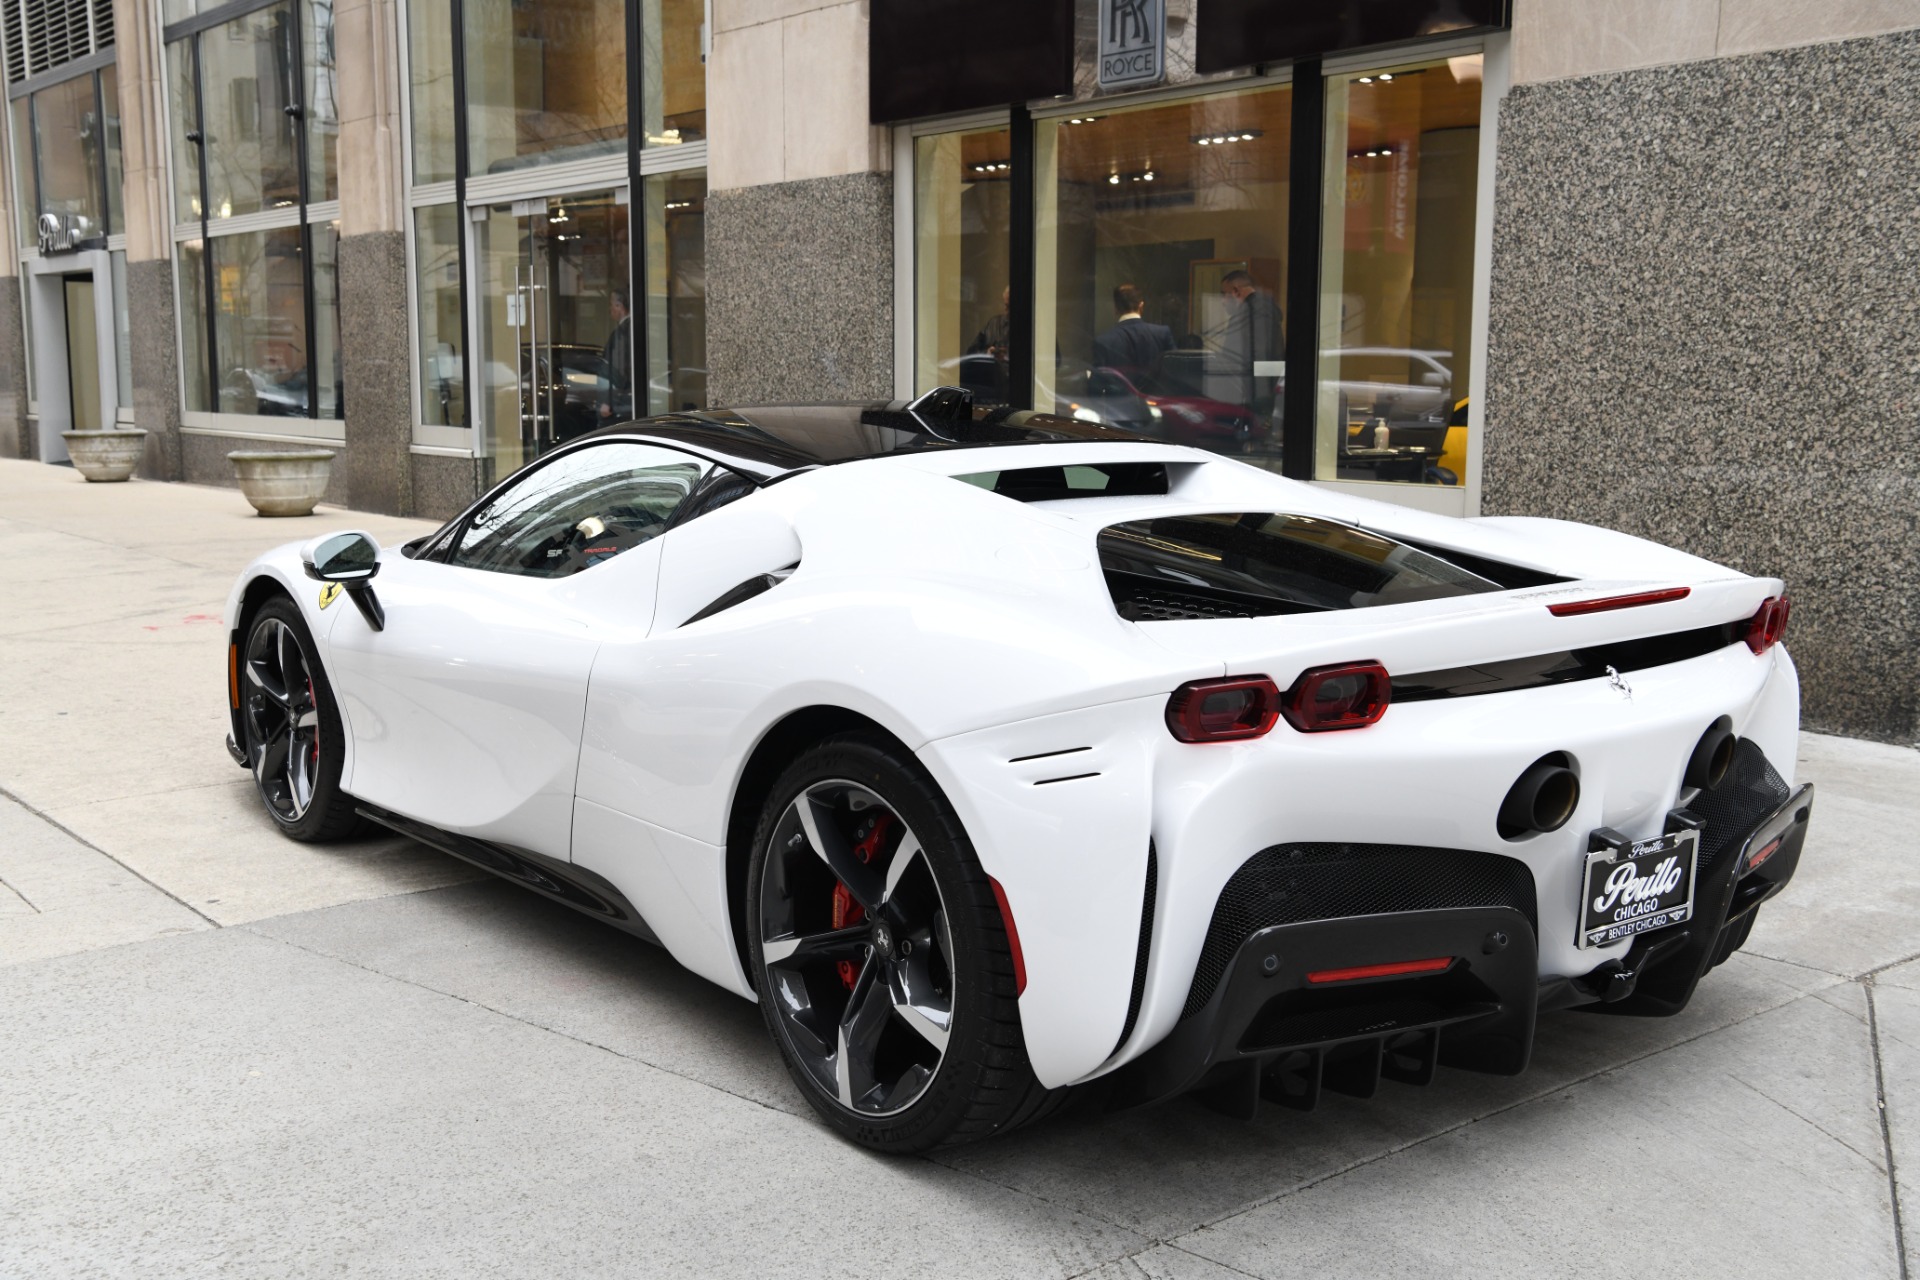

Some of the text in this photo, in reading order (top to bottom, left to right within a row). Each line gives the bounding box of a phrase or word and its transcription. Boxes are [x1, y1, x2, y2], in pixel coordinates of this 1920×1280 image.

[1104, 53, 1152, 77] ROYCE
[1628, 840, 1664, 859] Perillo
[1593, 856, 1682, 913] Perillo
[1614, 898, 1658, 921] CHICAGO
[1608, 914, 1667, 940] BENTLEY CHICAGO
